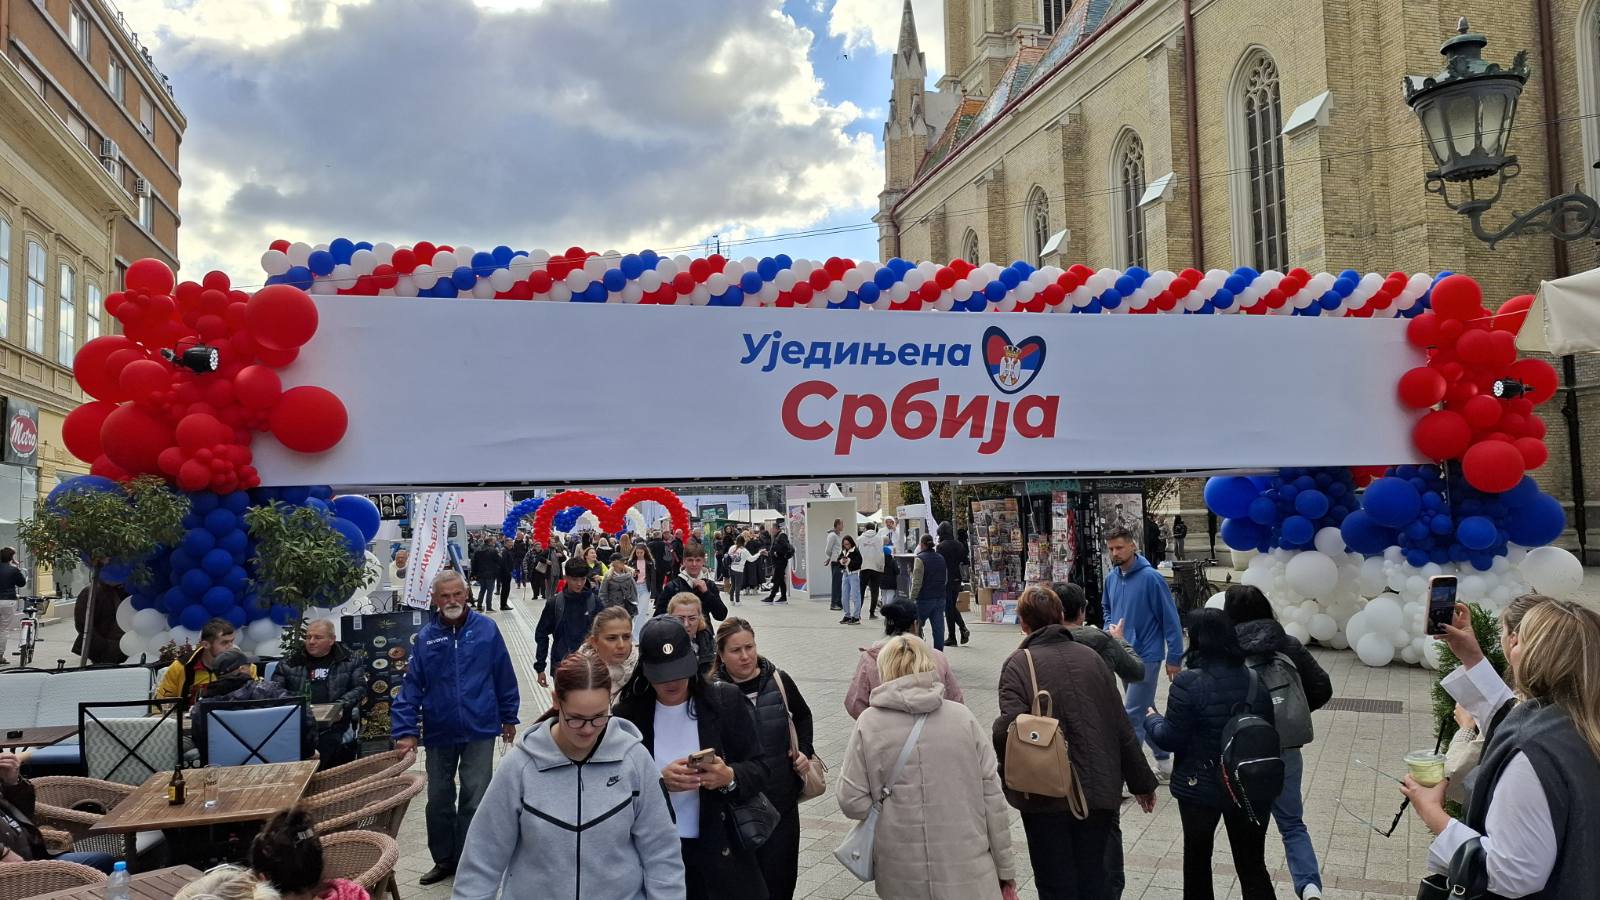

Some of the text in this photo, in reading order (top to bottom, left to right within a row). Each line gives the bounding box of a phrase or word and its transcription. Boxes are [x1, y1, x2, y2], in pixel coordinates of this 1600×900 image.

[740, 330, 972, 373] Уједињена
[11, 419, 37, 446] Metro
[781, 378, 1060, 455] Србија
